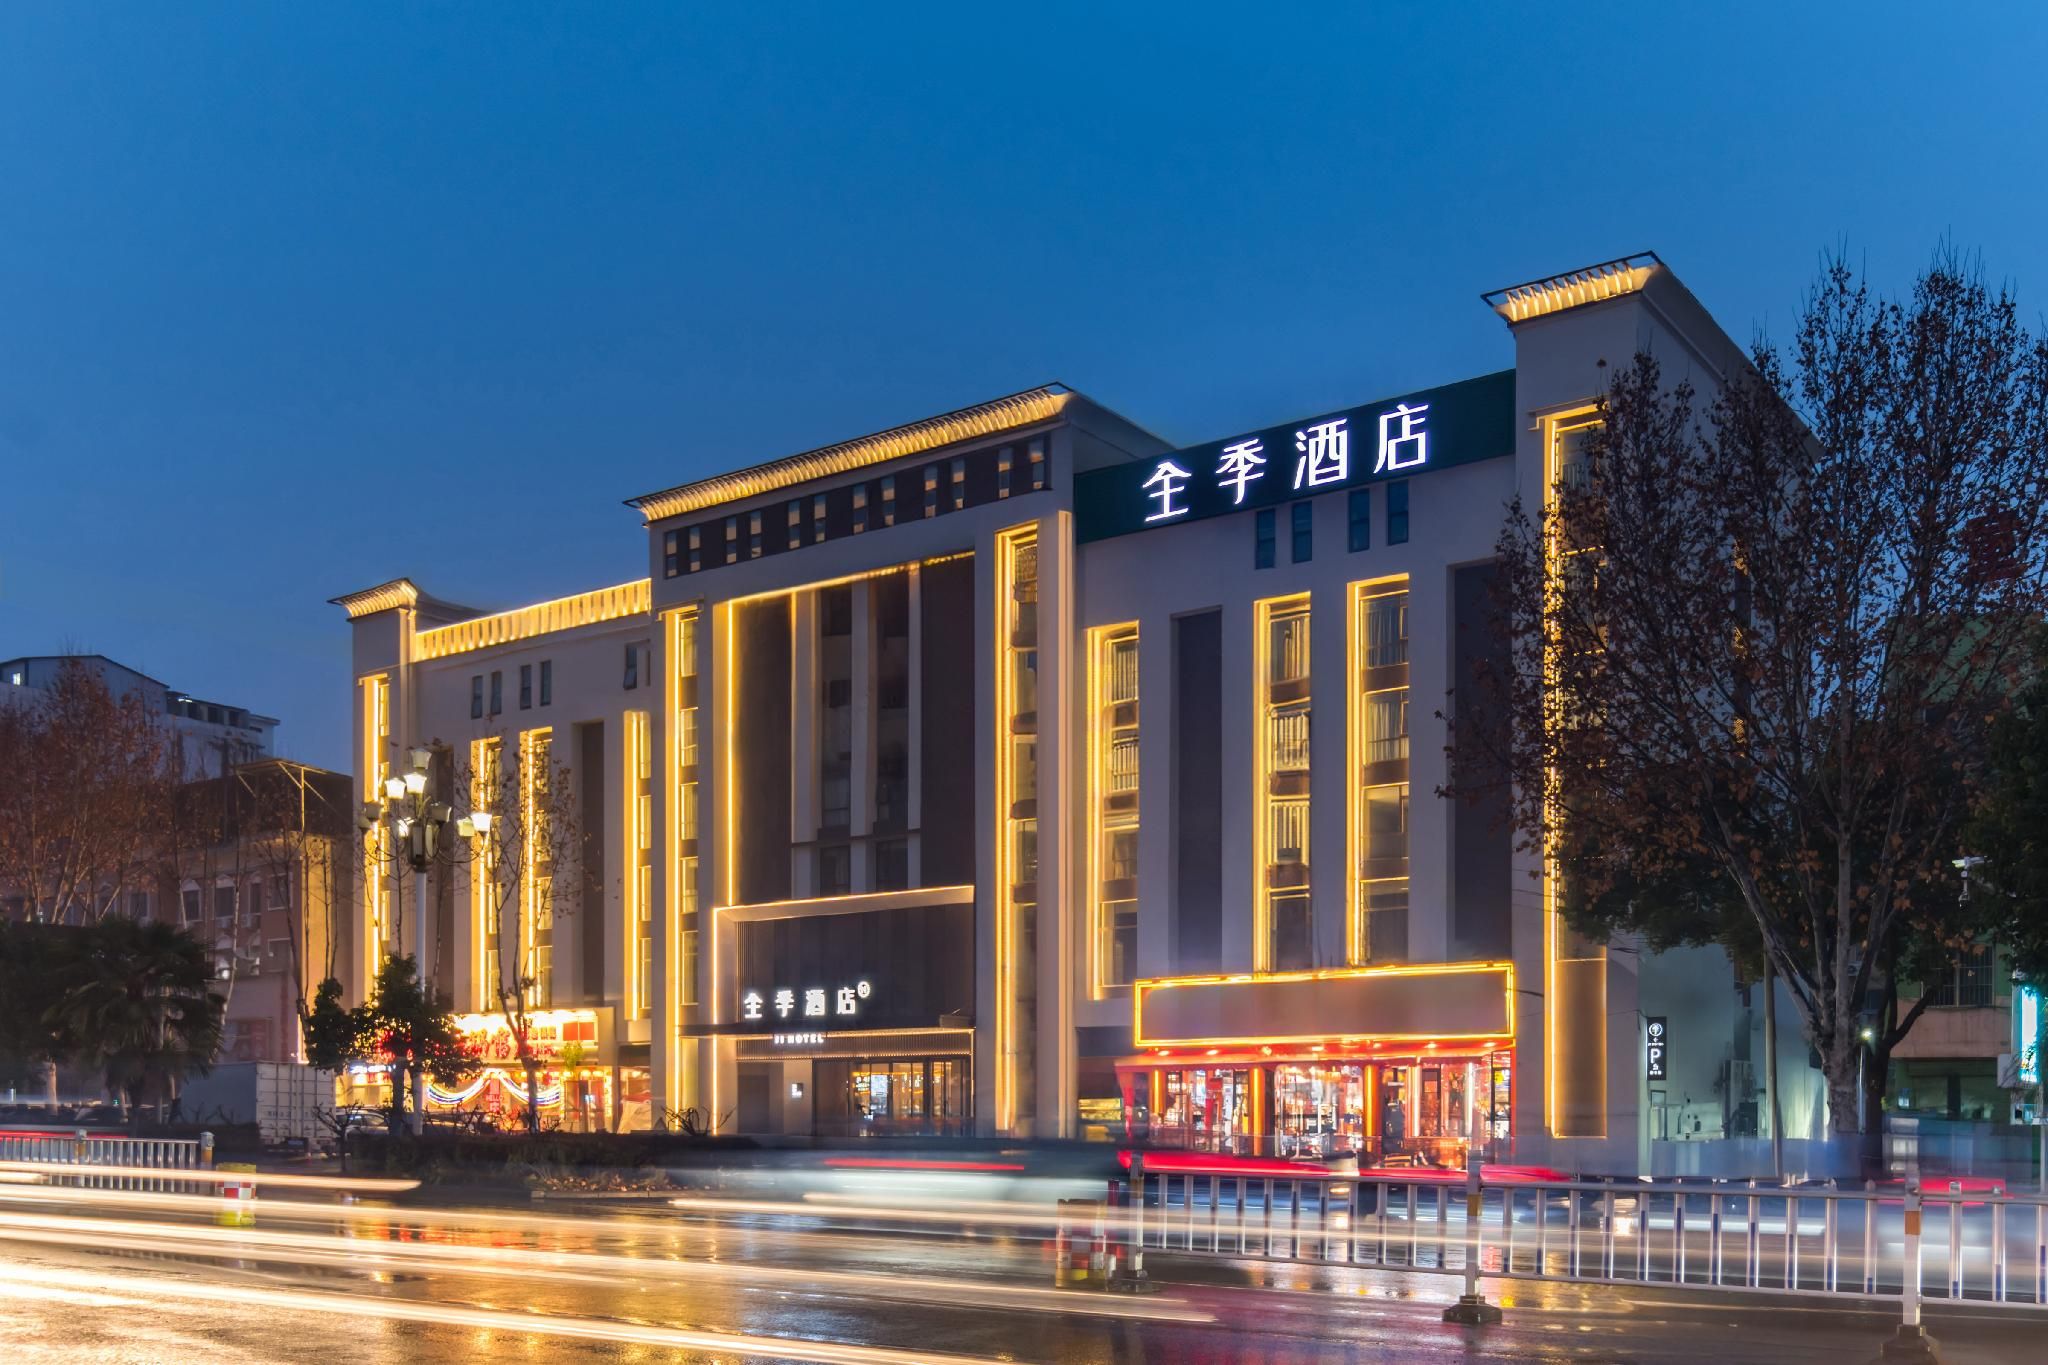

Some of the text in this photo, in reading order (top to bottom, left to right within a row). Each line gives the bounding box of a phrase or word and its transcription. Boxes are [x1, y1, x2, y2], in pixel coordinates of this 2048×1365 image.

[1141, 403, 1430, 523] 全季酒店
[787, 1033, 824, 1044] HOTEL
[1650, 1048, 1662, 1064] P
